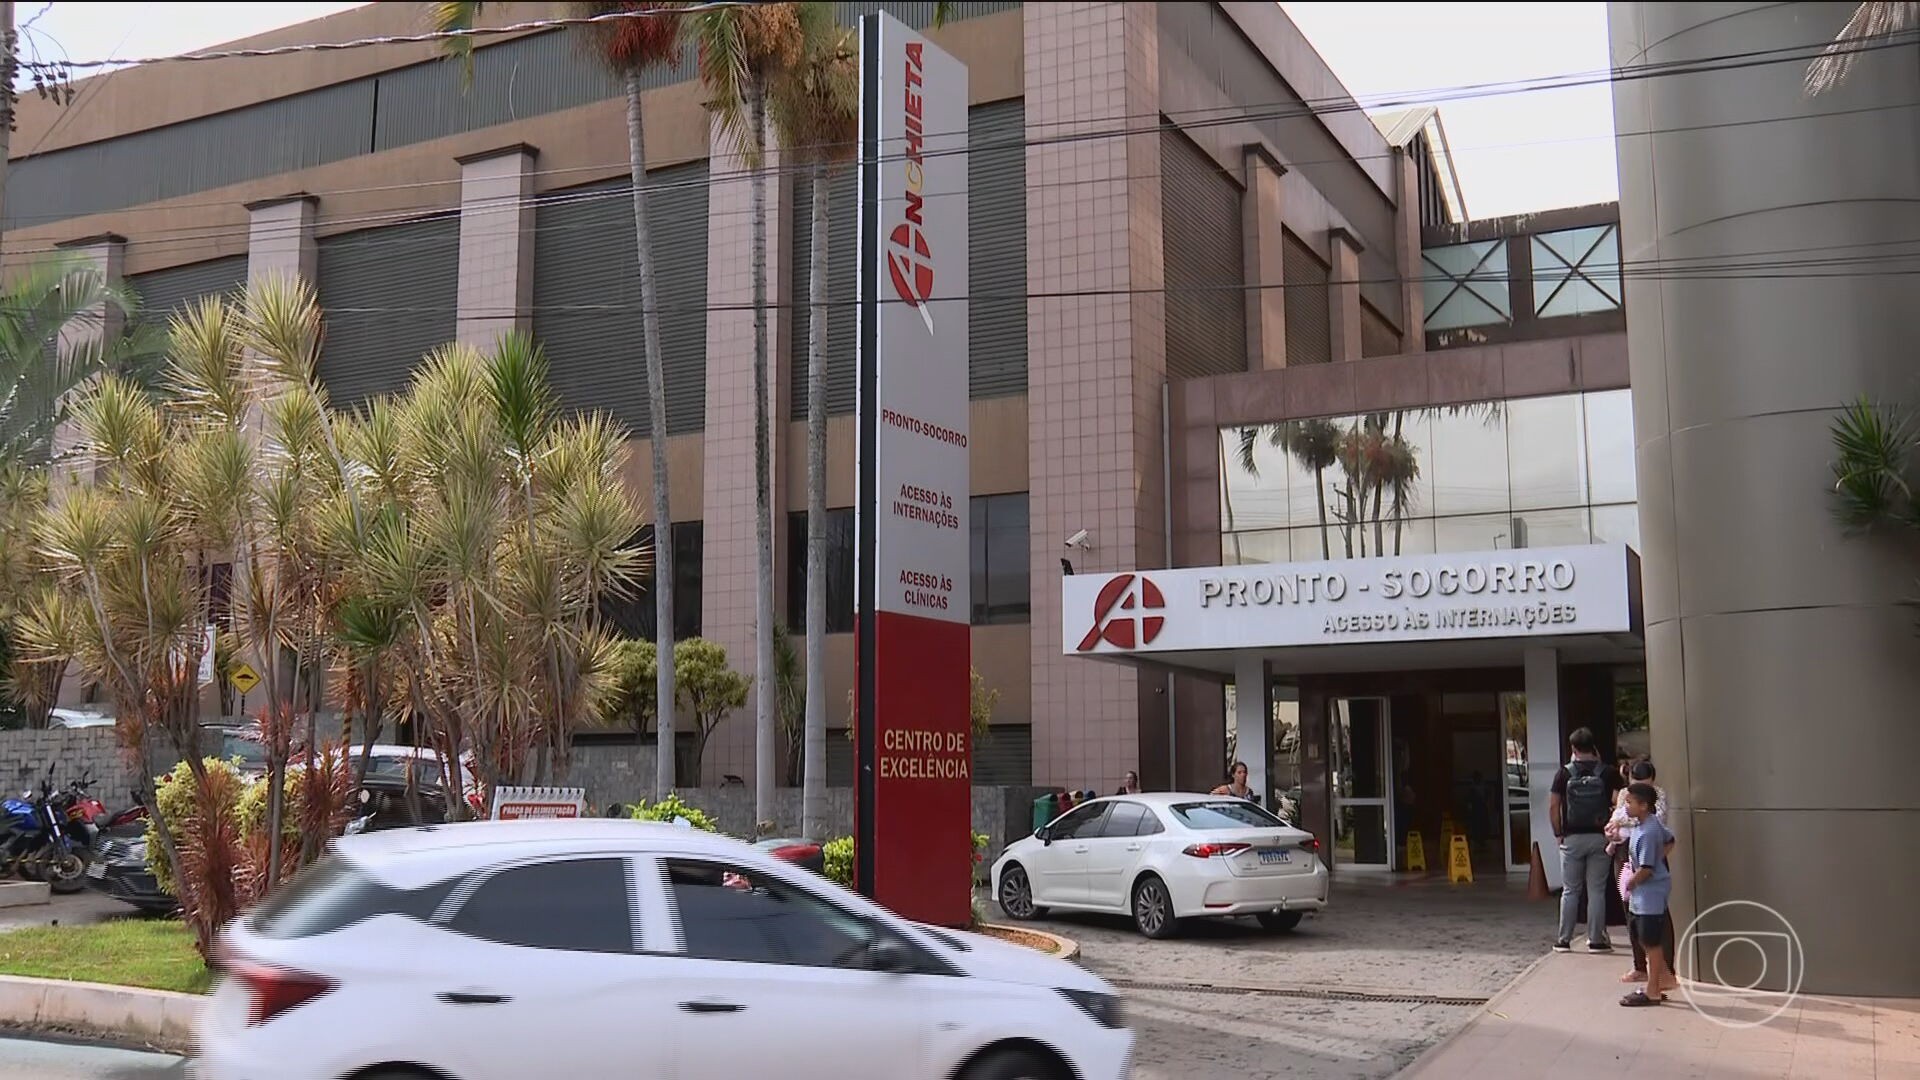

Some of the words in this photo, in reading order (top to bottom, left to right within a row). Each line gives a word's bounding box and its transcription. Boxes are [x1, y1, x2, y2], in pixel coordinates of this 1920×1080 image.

[882, 409, 968, 448] PRONTO-SOCORRO
[900, 483, 938, 506] ACESSO
[940, 491, 952, 509] ÀS
[893, 501, 959, 529] INTERNAÇÕES
[900, 569, 938, 589] ACESSO
[940, 574, 952, 592] ÀS
[1199, 573, 1347, 608] PRONTO
[1381, 560, 1576, 599] SOCORRO
[904, 588, 948, 610] CLÍNICAS
[1322, 613, 1399, 634] ACESSO
[1403, 606, 1430, 631] ÀS
[1436, 602, 1576, 630] INTERNAÇÕES
[884, 729, 943, 752] CENTRO
[946, 732, 965, 752] DE
[880, 752, 969, 779] EXCELÊNCIA
